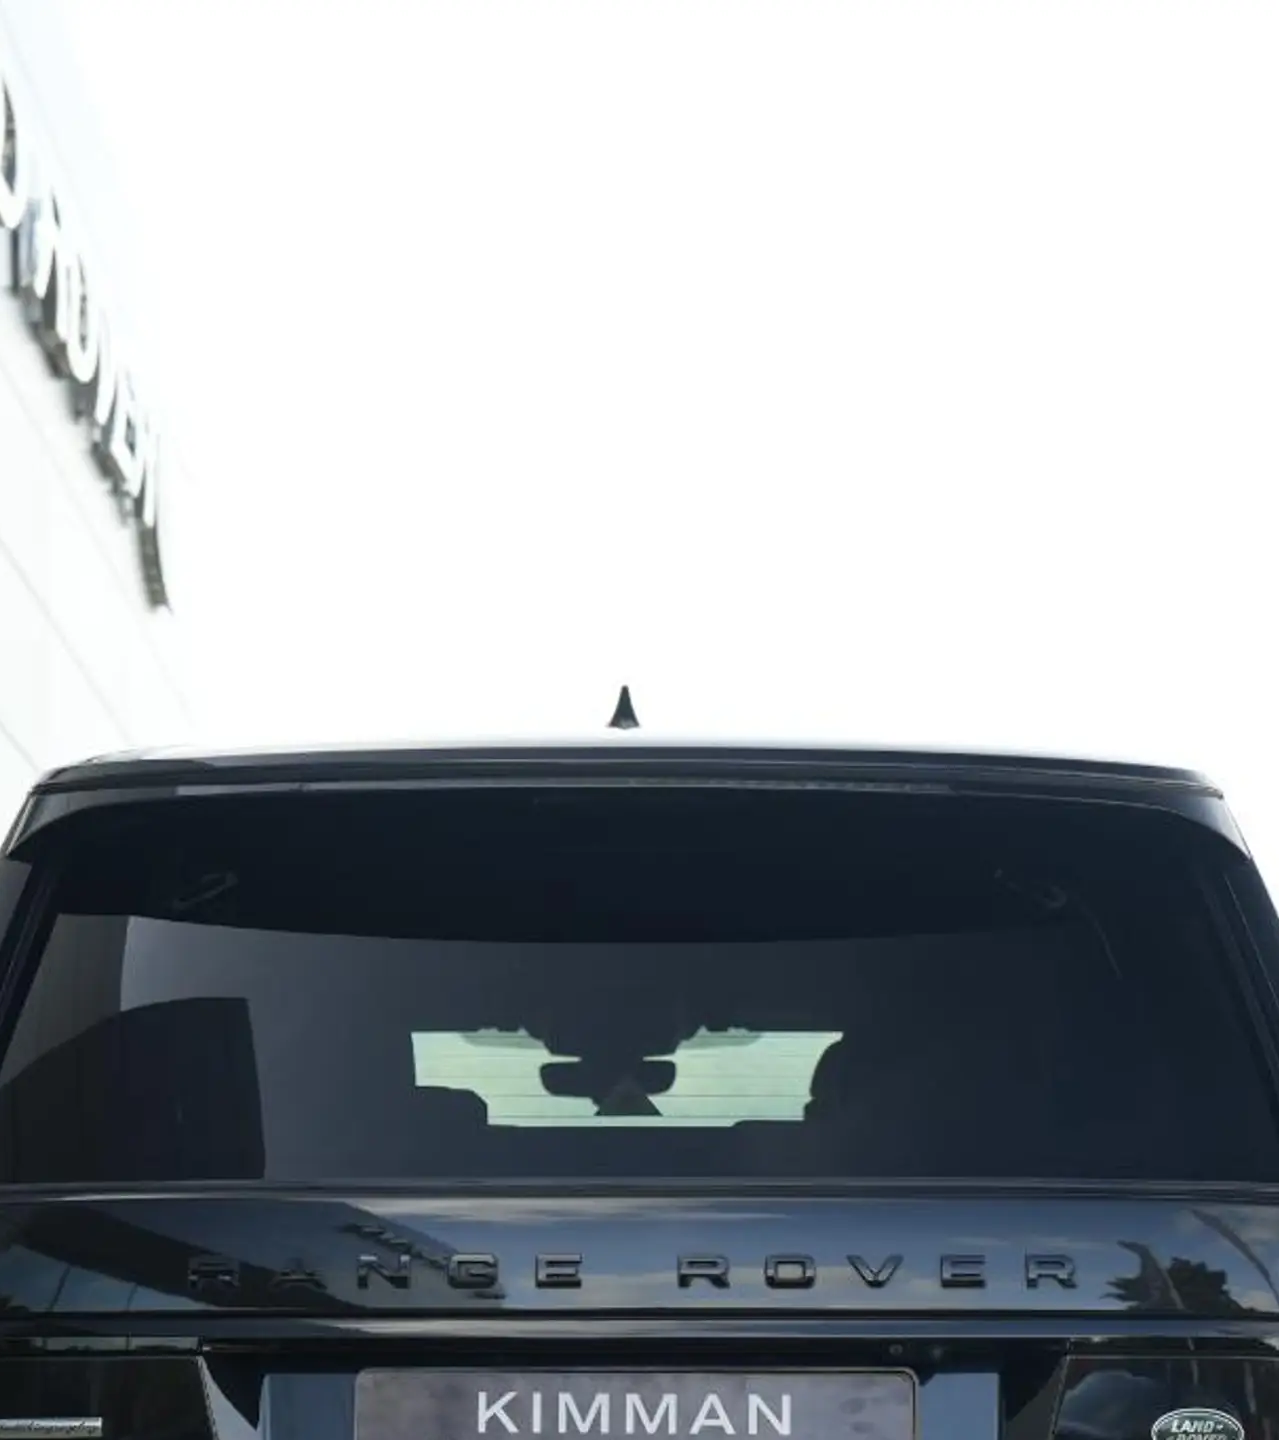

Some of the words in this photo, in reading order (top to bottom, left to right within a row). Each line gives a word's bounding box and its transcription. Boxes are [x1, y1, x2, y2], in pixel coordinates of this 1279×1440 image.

[187, 1252, 583, 1289] RANGE
[676, 1253, 1079, 1289] ROVER
[477, 1391, 792, 1436] KIMMAN
